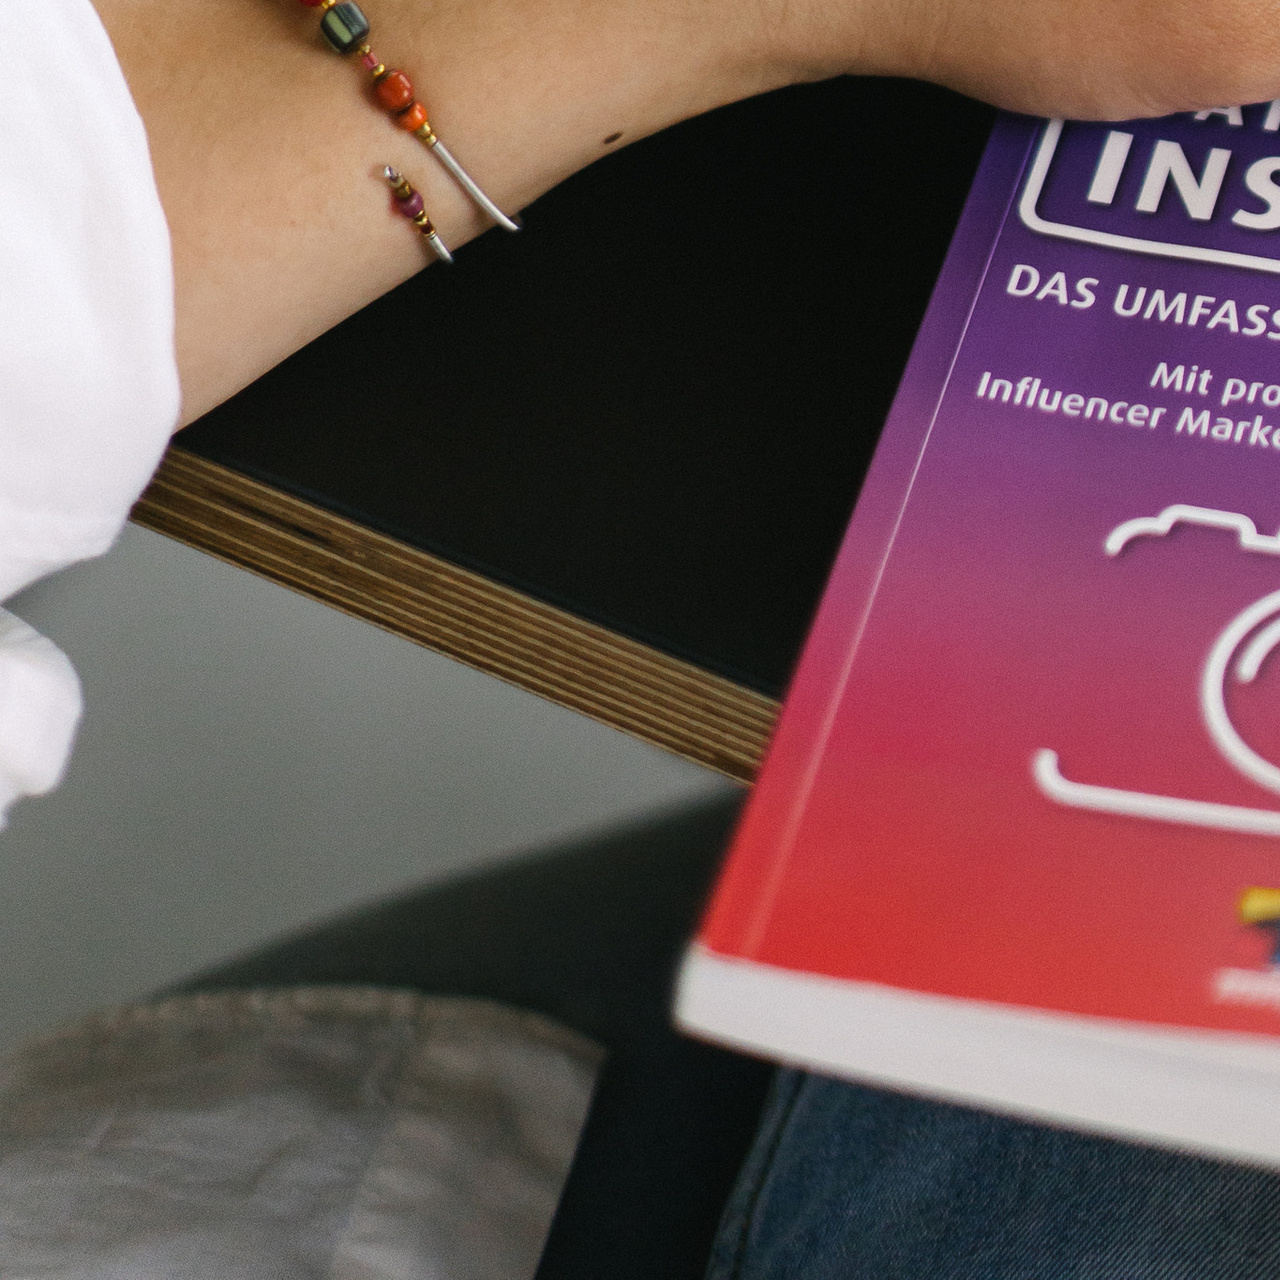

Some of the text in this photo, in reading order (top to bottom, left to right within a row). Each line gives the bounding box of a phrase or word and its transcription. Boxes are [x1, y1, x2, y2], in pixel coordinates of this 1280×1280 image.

[1005, 263, 1099, 309] DAS
[976, 370, 1167, 430] Influencer
[1149, 361, 1214, 396] Mit
